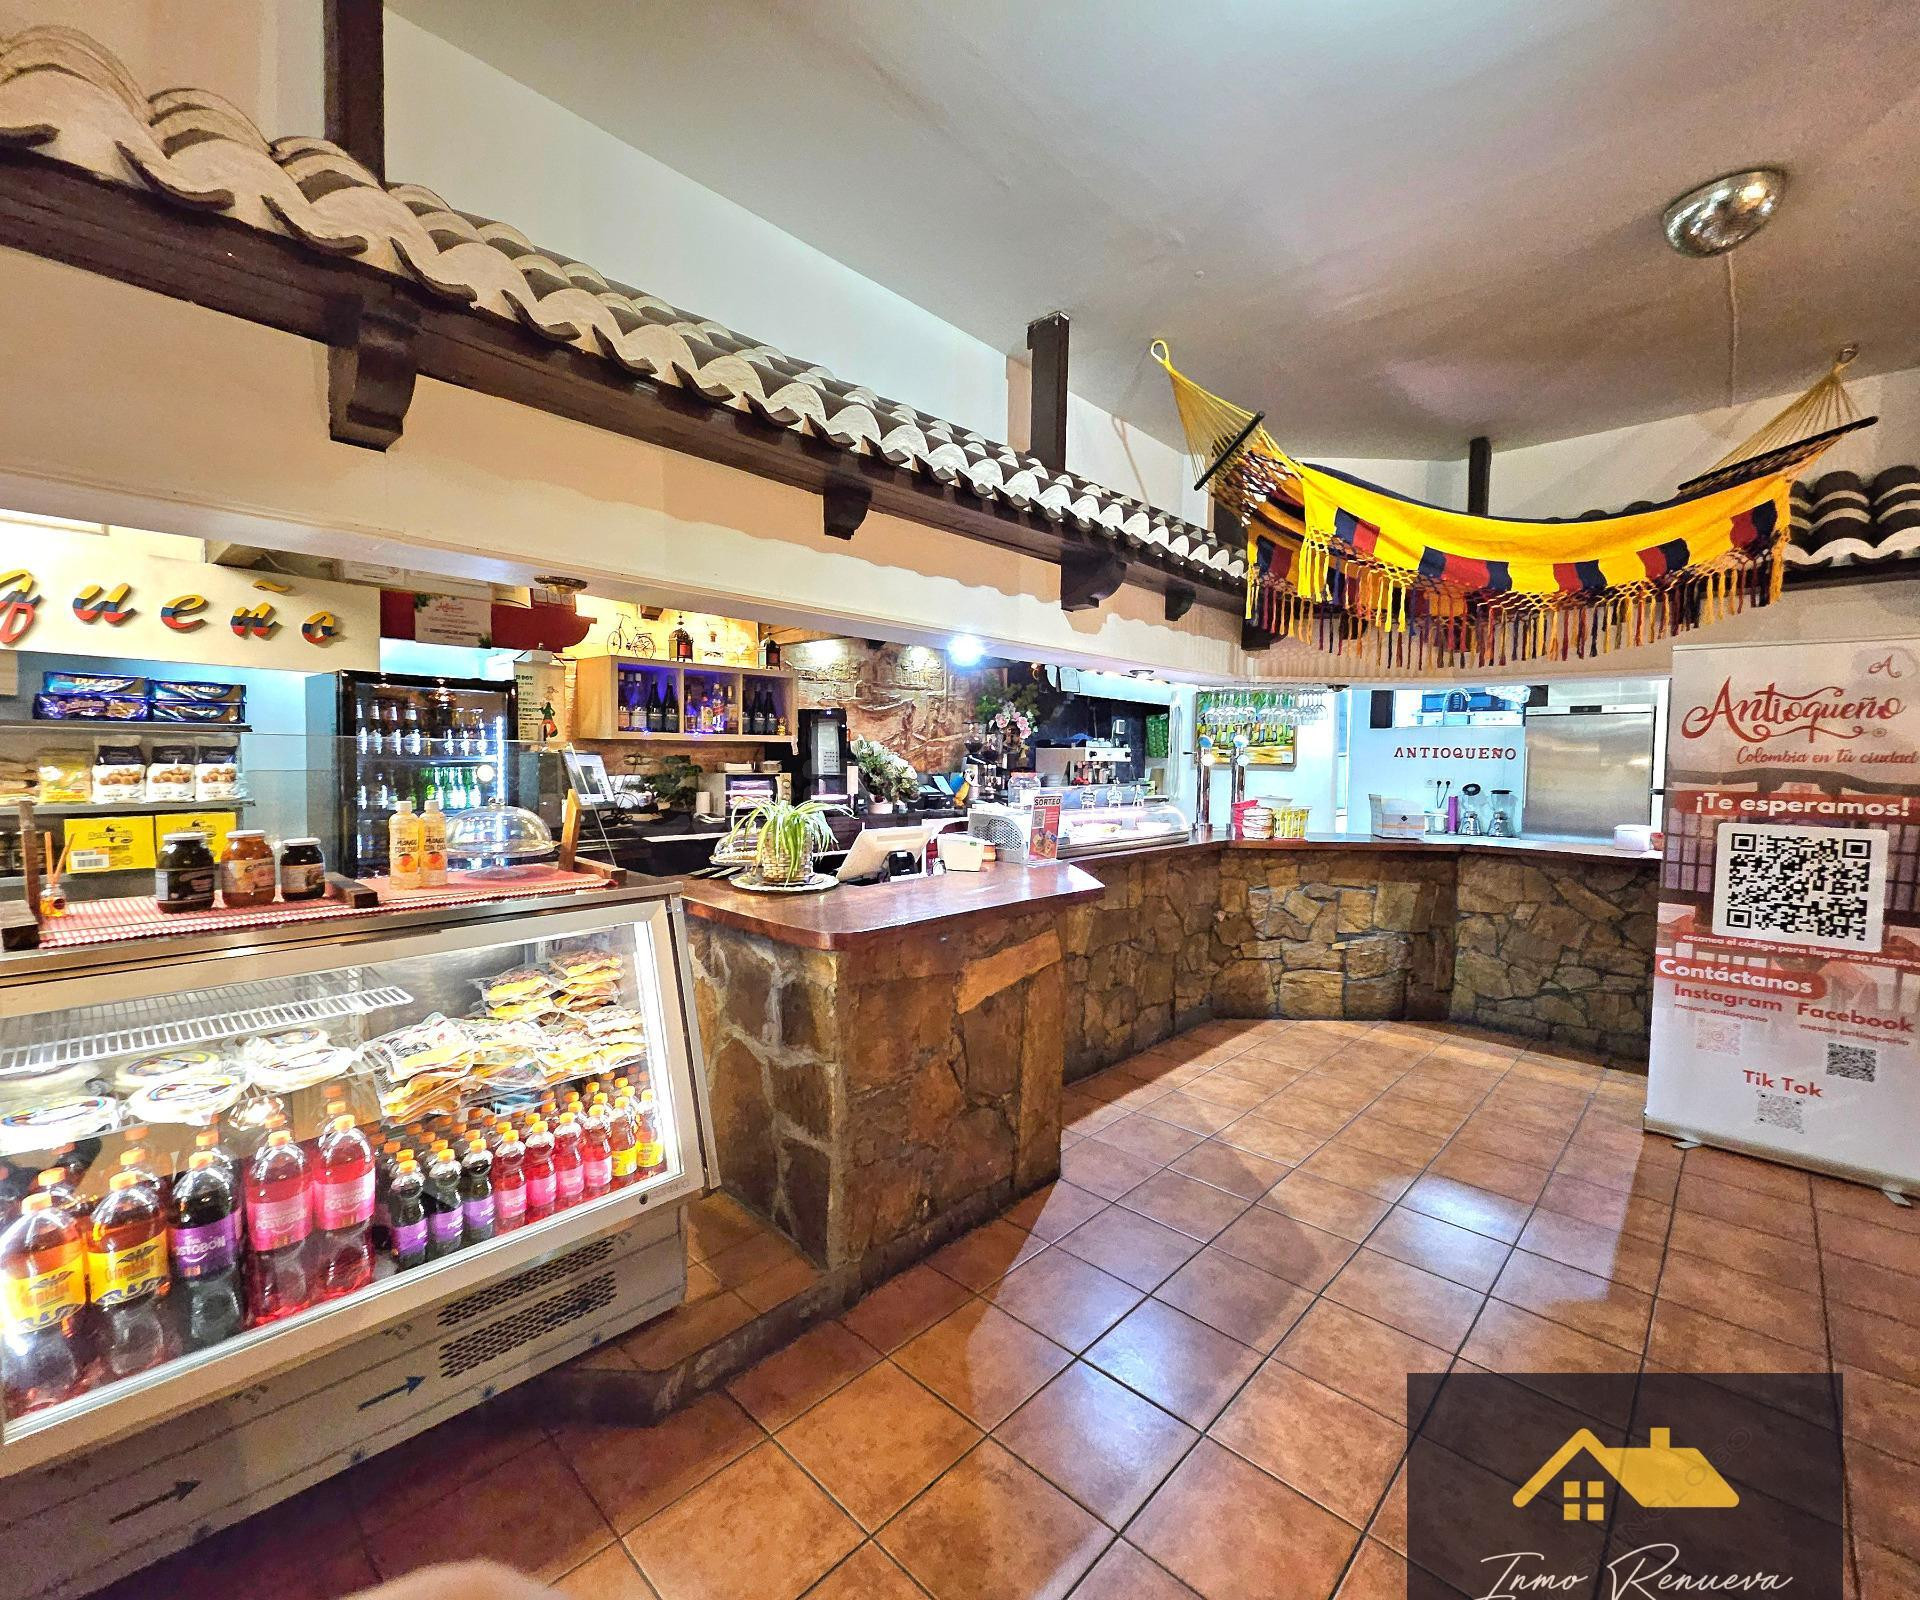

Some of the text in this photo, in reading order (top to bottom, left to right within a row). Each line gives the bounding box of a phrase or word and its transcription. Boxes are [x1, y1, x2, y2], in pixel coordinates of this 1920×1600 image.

[1681, 675, 1907, 744] Antioqueño
[1393, 746, 1517, 761] ANTIOQUEÑO
[1736, 746, 1808, 765] Colombia
[1812, 754, 1833, 764] en
[1859, 750, 1919, 764] ciudad
[1034, 797, 1061, 807] SORTEO
[1695, 792, 1911, 817] ¡Te esperamos!
[1726, 938, 1737, 946] el
[1738, 940, 1777, 952] código
[1778, 945, 1807, 954] para
[1808, 947, 1846, 959] llegar
[1847, 953, 1870, 962] con
[1660, 958, 1813, 994] Contáctanos
[1674, 983, 1915, 1033] Instagram Facebook
[1742, 1069, 1823, 1098] Tik Tok
